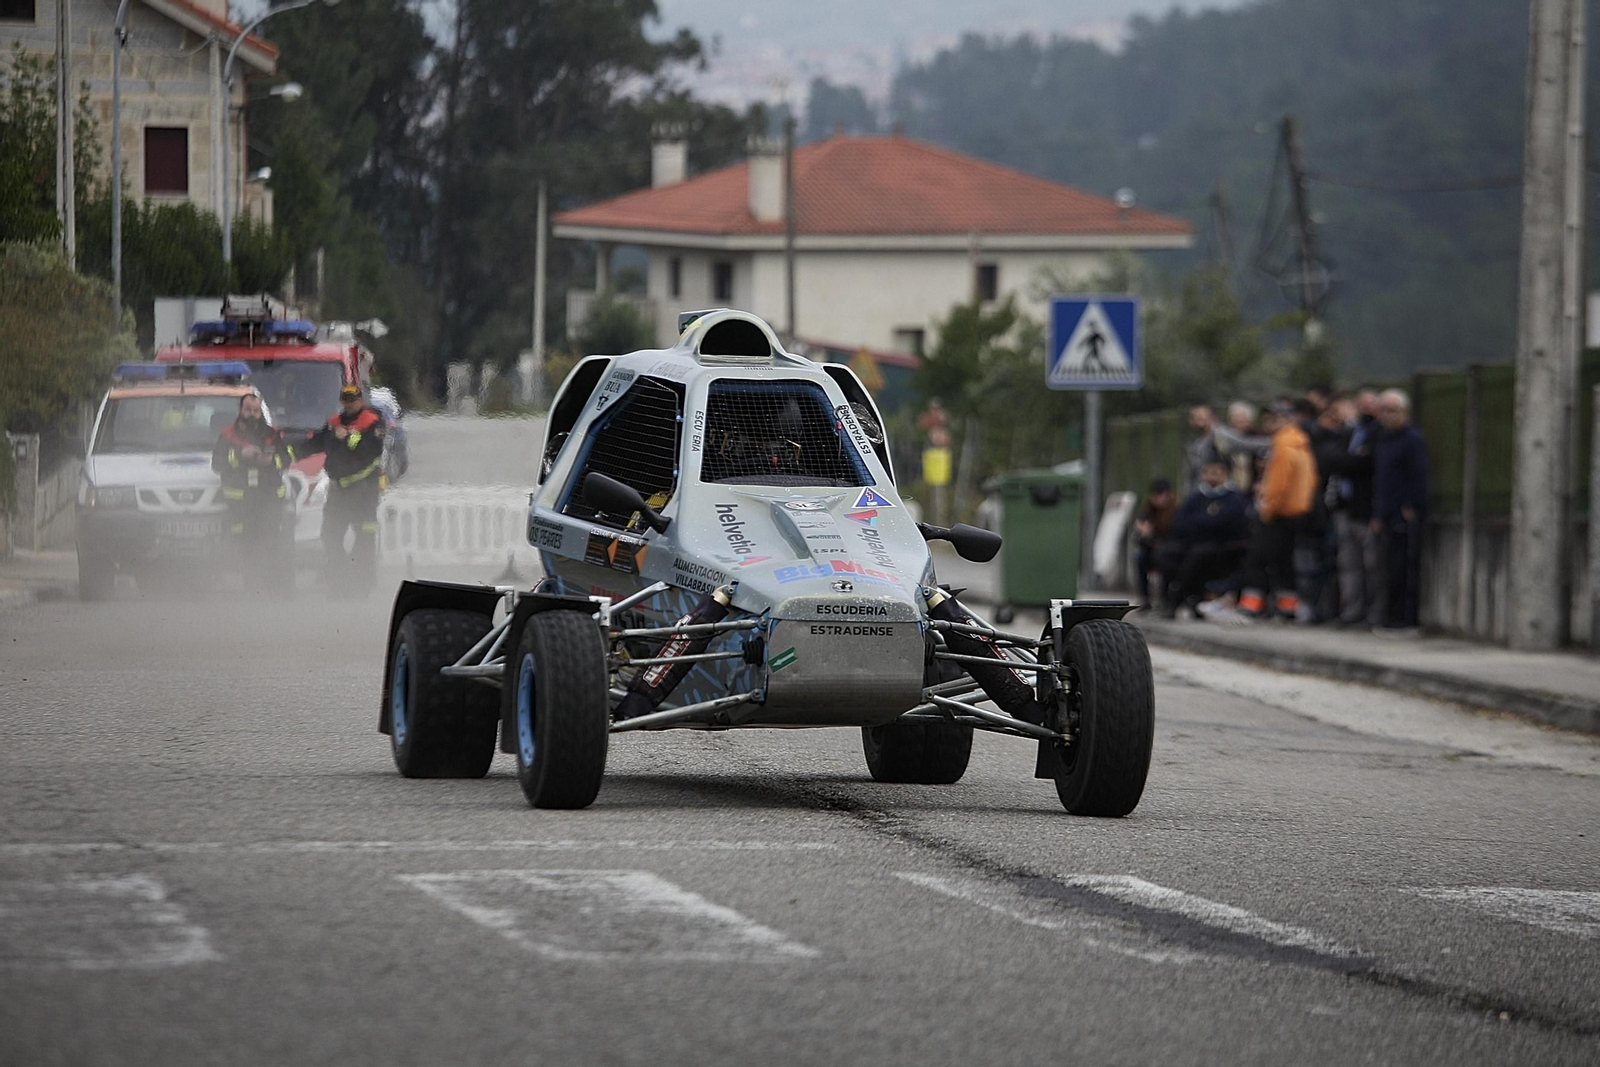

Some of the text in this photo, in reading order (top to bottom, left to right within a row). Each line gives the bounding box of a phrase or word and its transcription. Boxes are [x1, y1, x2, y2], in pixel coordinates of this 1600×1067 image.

[604, 380, 622, 394] BUA
[691, 410, 705, 452] ESCUERIA
[714, 502, 757, 555] helvetia
[857, 527, 896, 569] helvetia
[672, 557, 727, 583] ALIMENTACION
[816, 604, 888, 616] ESCUDERIA
[810, 625, 894, 636] ESTRADENSE
